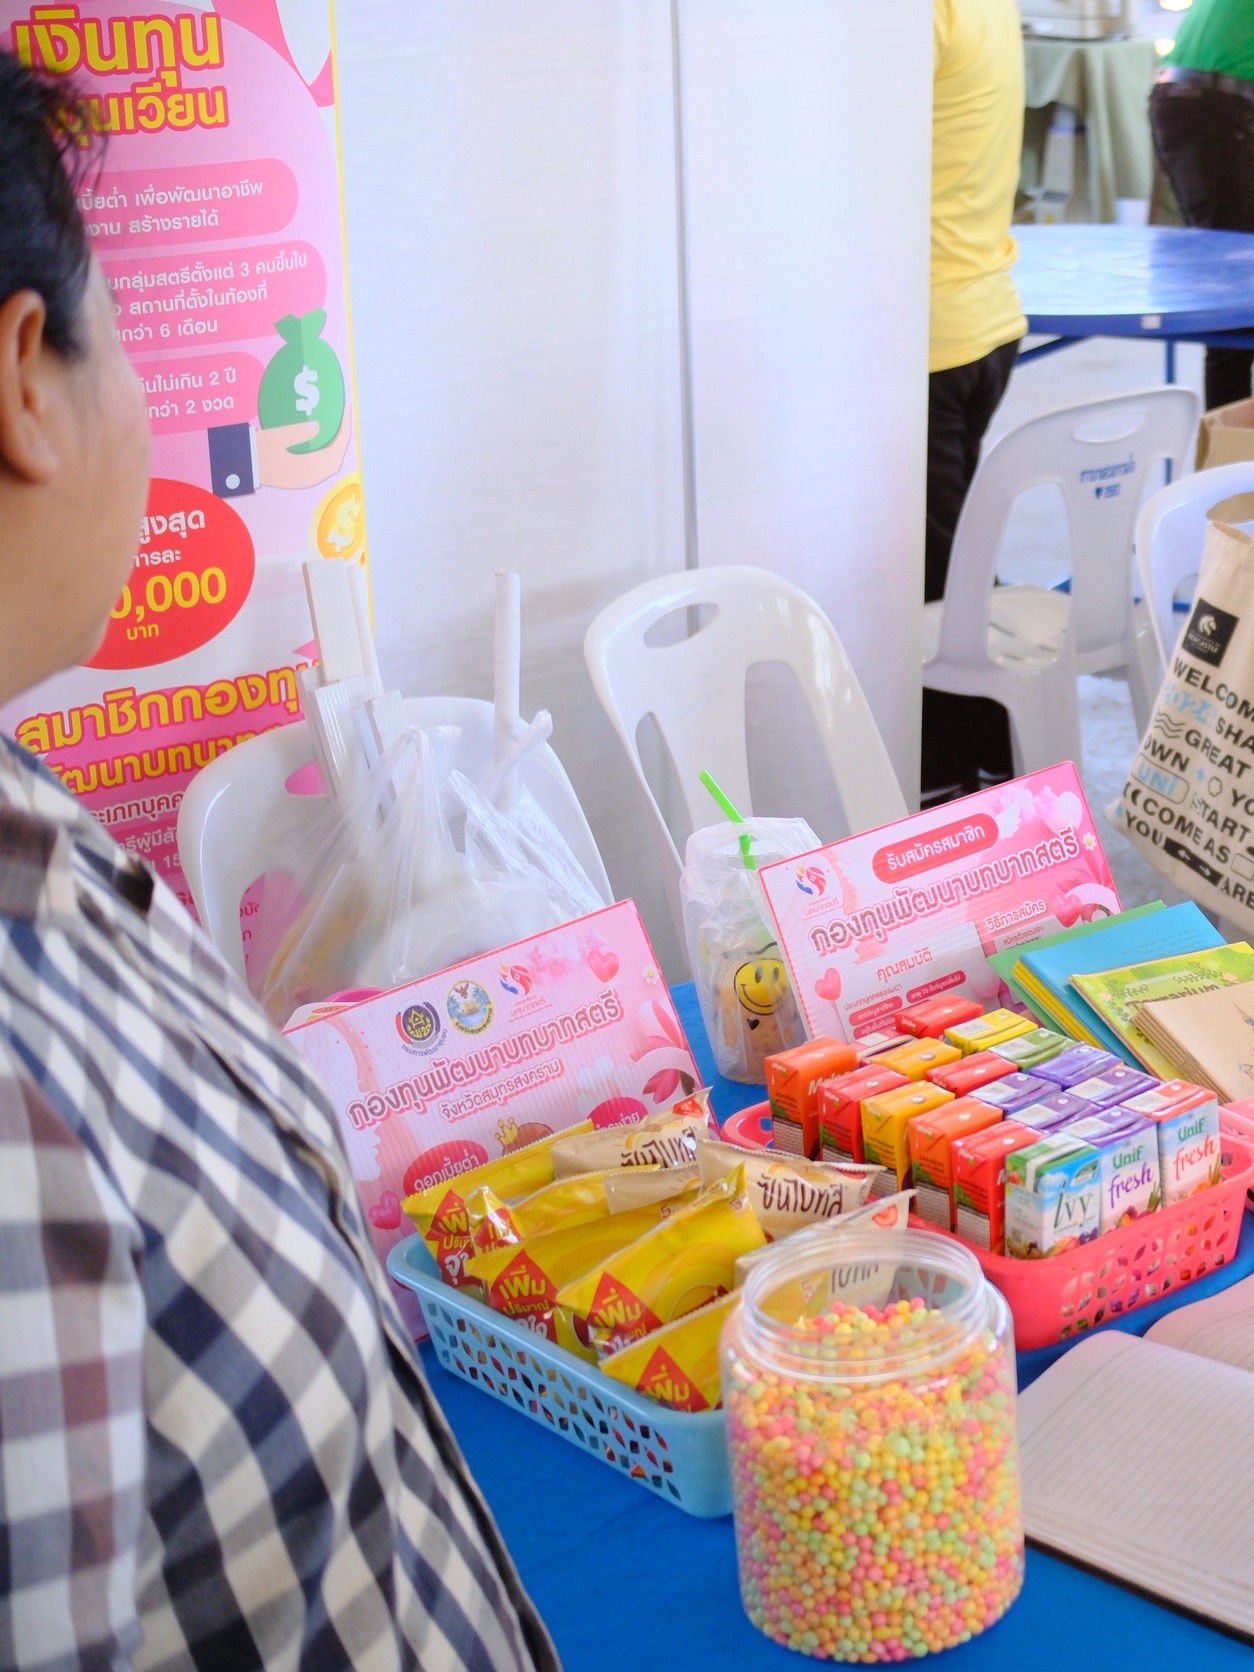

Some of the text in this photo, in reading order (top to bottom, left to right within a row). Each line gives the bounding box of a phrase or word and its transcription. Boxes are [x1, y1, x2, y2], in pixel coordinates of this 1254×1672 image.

[14, 8, 221, 87] เงินทุน
[77, 179, 263, 211] เบี้ยต่ำ เพื่อพัฒนาอาชีพ
[128, 208, 219, 233] สร้างรายได้
[240, 262, 251, 277] 3
[256, 250, 308, 275] คนขึ้นไป
[129, 279, 269, 316] สถานที่ตั้งในท้องที่
[160, 323, 171, 337] 6
[177, 318, 218, 336] เดือน
[209, 371, 220, 386] 2
[224, 366, 237, 384] ปี
[185, 399, 196, 415] 2
[201, 396, 235, 412] งวด
[126, 623, 160, 641] บาท
[17, 663, 302, 755] สมาชิกกองทุ
[1185, 728, 1252, 779] GREAT
[1125, 809, 1164, 847] YOU
[1142, 797, 1231, 865] COME AS
[886, 823, 986, 871] รับสมัครสมาชิก
[810, 826, 1079, 952] กองทุนพัฒนาบทบาทสตรี
[986, 899, 1047, 932] วิธีการสมัคร
[877, 947, 933, 982] คุณสมบัติ
[349, 992, 621, 1128] กองทุนพัฒนาบทบาทสตรี
[441, 1059, 562, 1121] จังหวัดสมุทรสงคราม
[1178, 1117, 1206, 1142] Unif
[1113, 1145, 1144, 1169] Unif
[1173, 1134, 1215, 1180] fresh
[757, 1173, 844, 1217] ซันไบทส์
[1108, 1161, 1152, 1208] fresh
[499, 1265, 547, 1300] เพิ่ม
[594, 1287, 642, 1328] เพิ่ม
